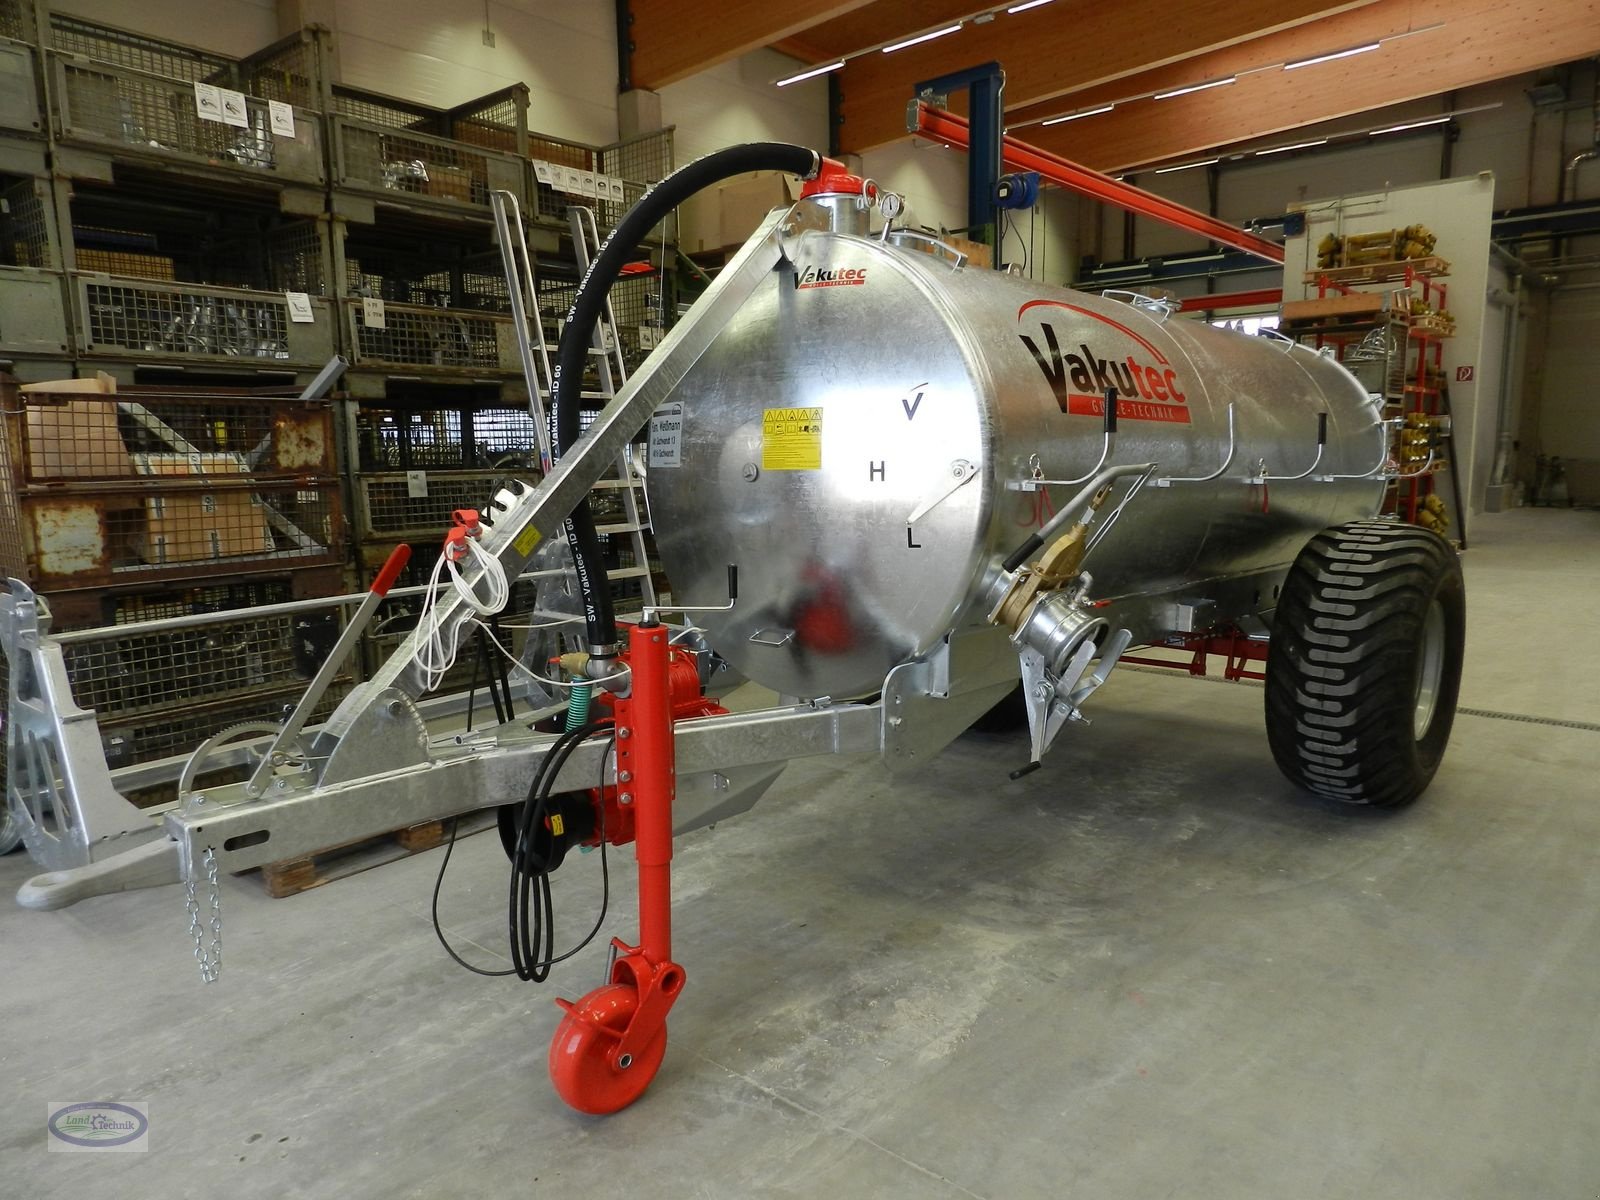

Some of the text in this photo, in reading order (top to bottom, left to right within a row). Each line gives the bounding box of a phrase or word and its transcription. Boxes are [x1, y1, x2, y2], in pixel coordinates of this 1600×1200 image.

[566, 305, 577, 323] SW
[576, 258, 599, 297] Vakutec
[600, 241, 609, 252] ID
[607, 228, 618, 240] 60
[793, 265, 867, 290] Vakutec
[553, 364, 562, 378] 60
[1018, 322, 1186, 414] Vakutec
[552, 380, 560, 393] ID
[902, 392, 924, 421] V
[1091, 400, 1174, 419] GÜE-TECHNIK
[870, 460, 885, 482] H
[565, 518, 574, 531] 60
[569, 533, 578, 545] ID
[907, 527, 922, 548] L
[576, 553, 591, 595] Vakutec
[586, 604, 596, 622] SW
